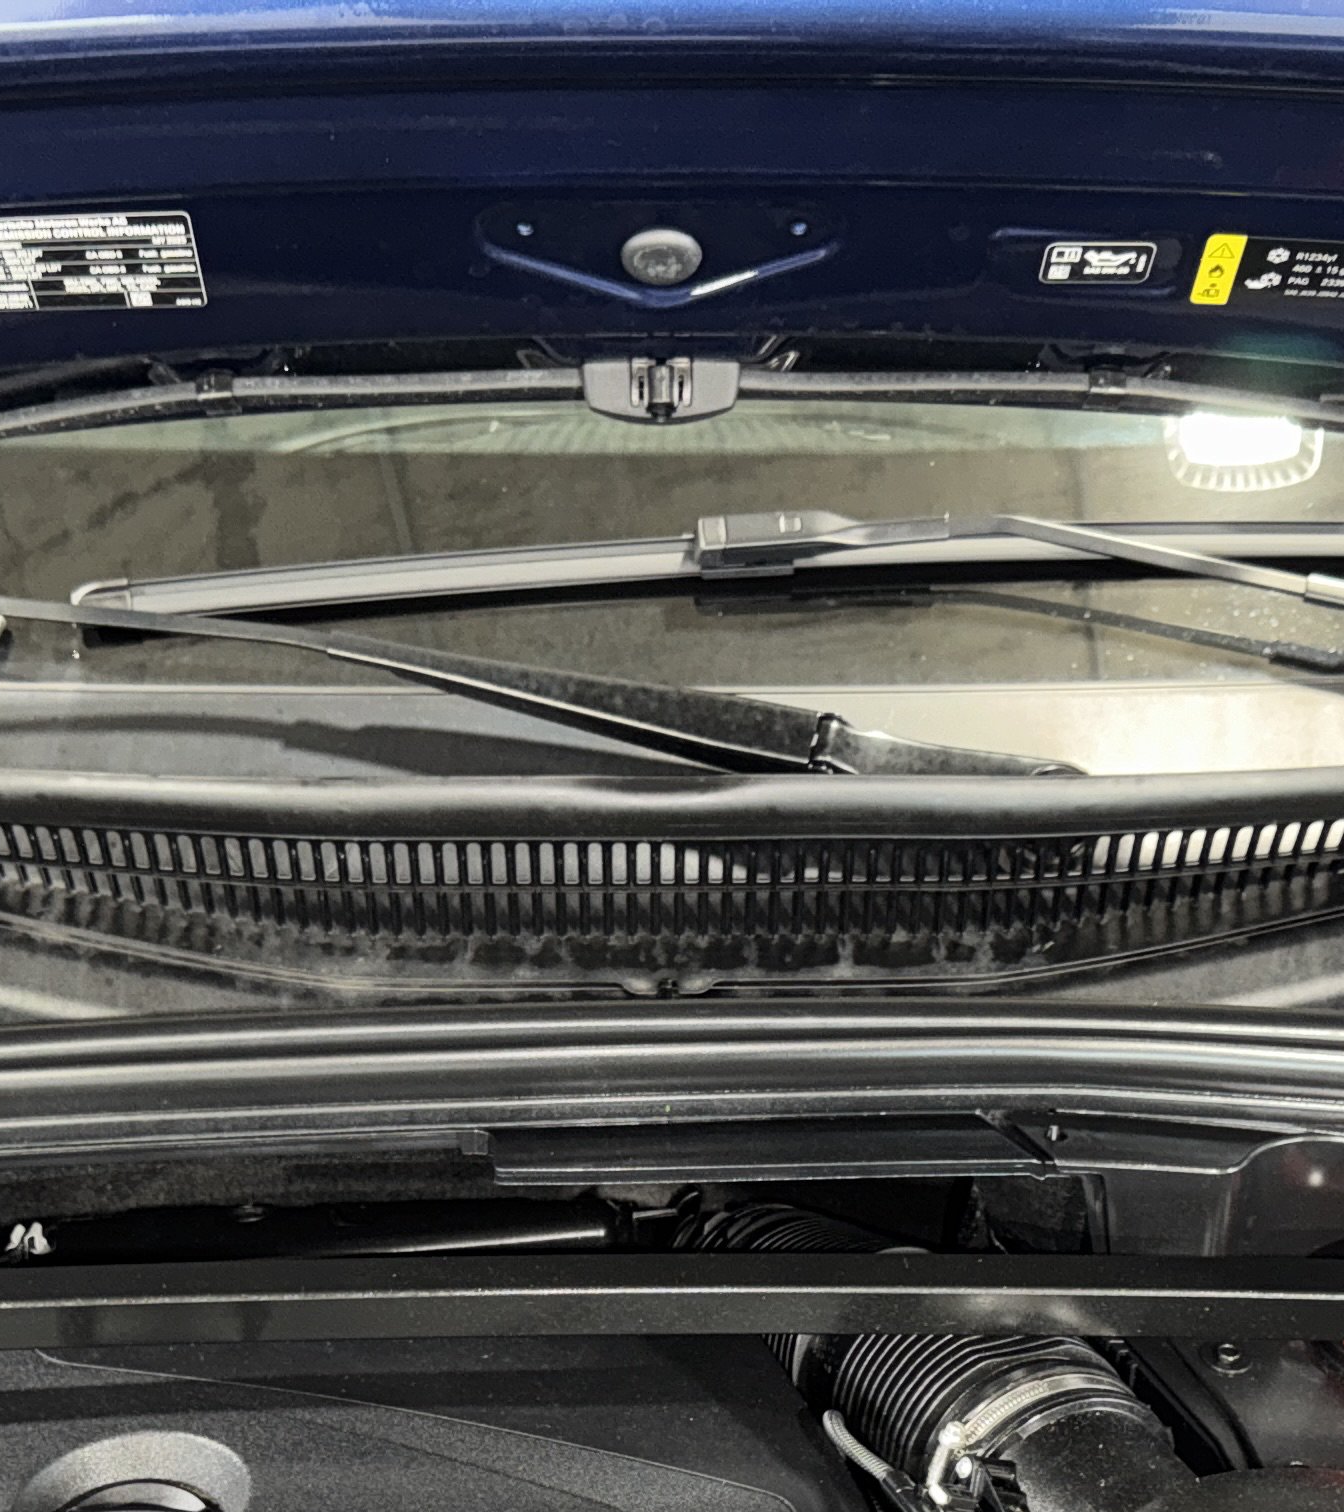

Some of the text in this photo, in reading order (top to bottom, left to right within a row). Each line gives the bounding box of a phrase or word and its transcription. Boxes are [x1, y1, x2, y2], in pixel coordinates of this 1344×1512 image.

[51, 227, 106, 239] CONTROL
[107, 224, 185, 238] INFORMATION
[1295, 252, 1338, 264] R1234yf
[1287, 276, 1310, 286] PAG
